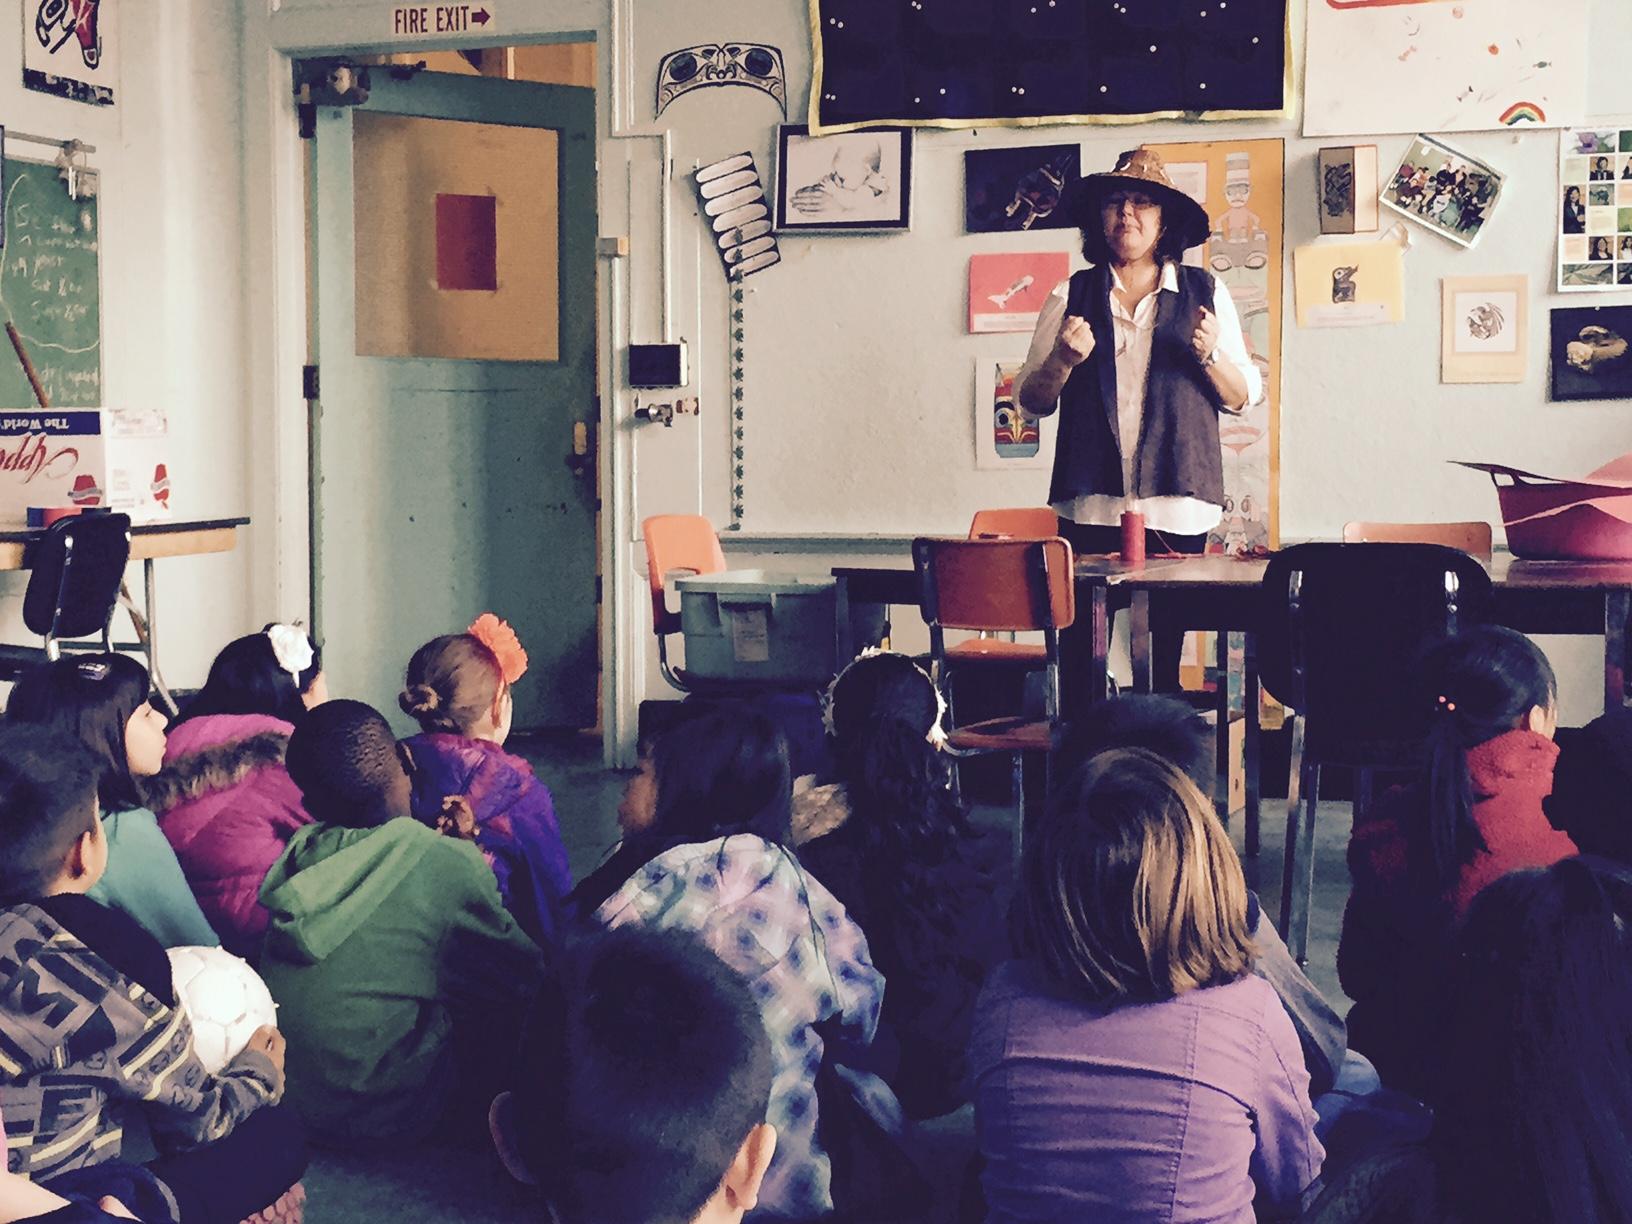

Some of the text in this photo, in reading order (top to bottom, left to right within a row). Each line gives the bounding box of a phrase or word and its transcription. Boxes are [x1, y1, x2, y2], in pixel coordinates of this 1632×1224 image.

[395, 6, 469, 33] FIRE EXIT
[0, 418, 70, 430] The World'
